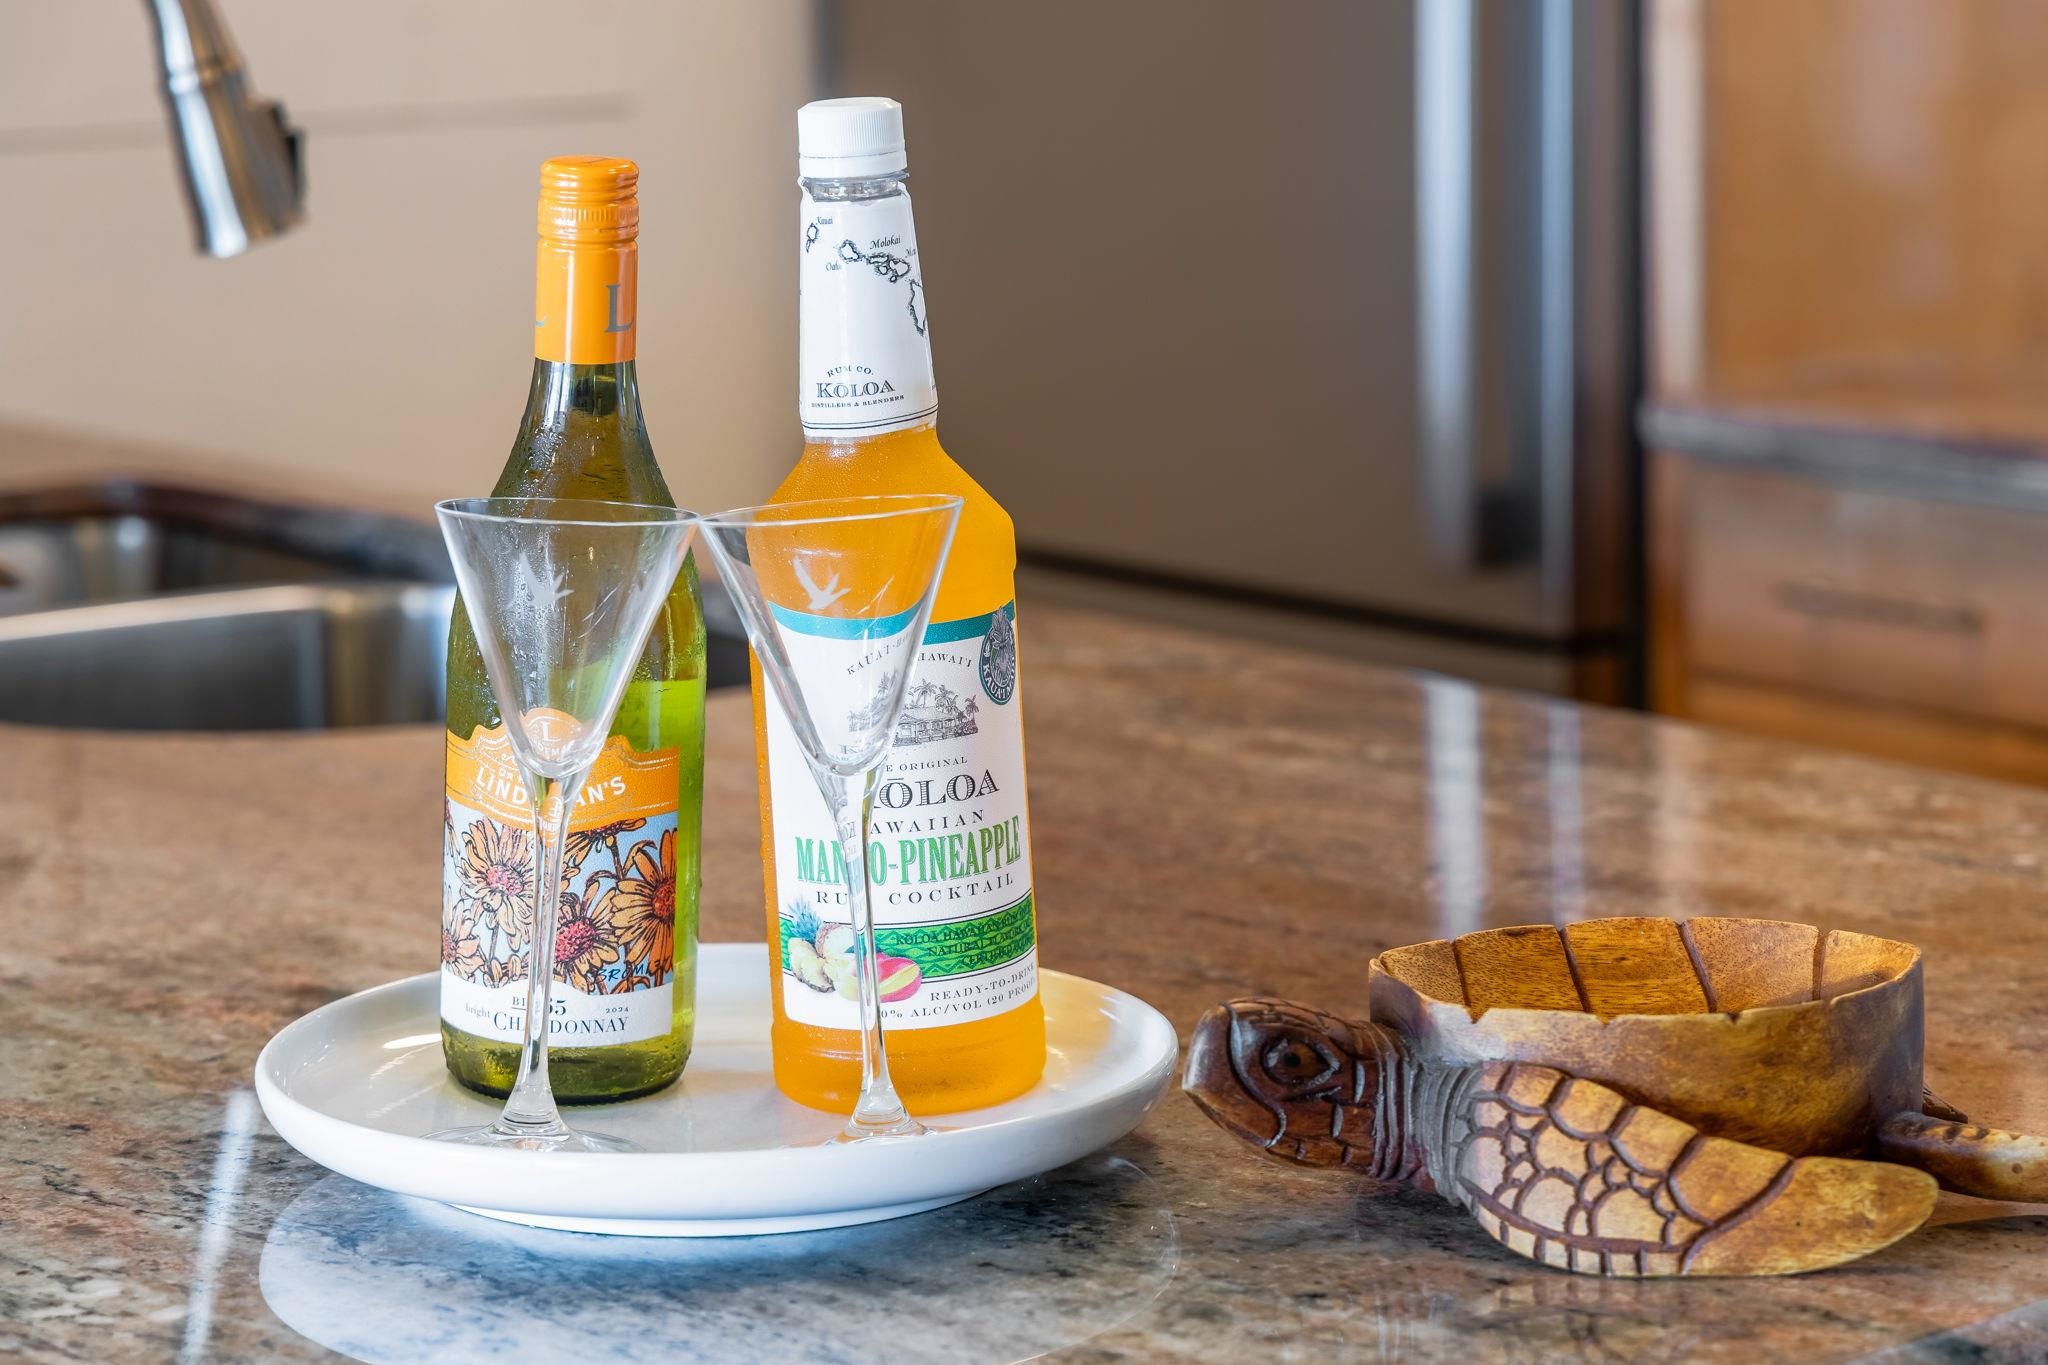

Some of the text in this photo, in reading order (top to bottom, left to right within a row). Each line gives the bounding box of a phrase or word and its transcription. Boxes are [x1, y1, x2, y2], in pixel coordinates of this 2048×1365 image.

[870, 235, 902, 250] Molokai
[604, 283, 634, 334] L
[827, 364, 875, 378] RUM CO.
[862, 394, 905, 407] BLENDERS
[899, 756, 968, 772] ORIGINAL
[476, 766, 626, 808] LINDAN'S
[873, 768, 1000, 809] ŌLOA
[869, 809, 985, 835] AWAIIAN
[795, 814, 1022, 887] MANO-PINEAPPLE
[816, 872, 1014, 906] RU COCKTAIL
[927, 938, 987, 957] NATURAL
[512, 996, 527, 1007] BI
[605, 1006, 630, 1015] 2024
[880, 1009, 904, 1019] 0%
[909, 999, 983, 1019] ALC/VOL
[493, 1008, 630, 1036] CHDONNAY
